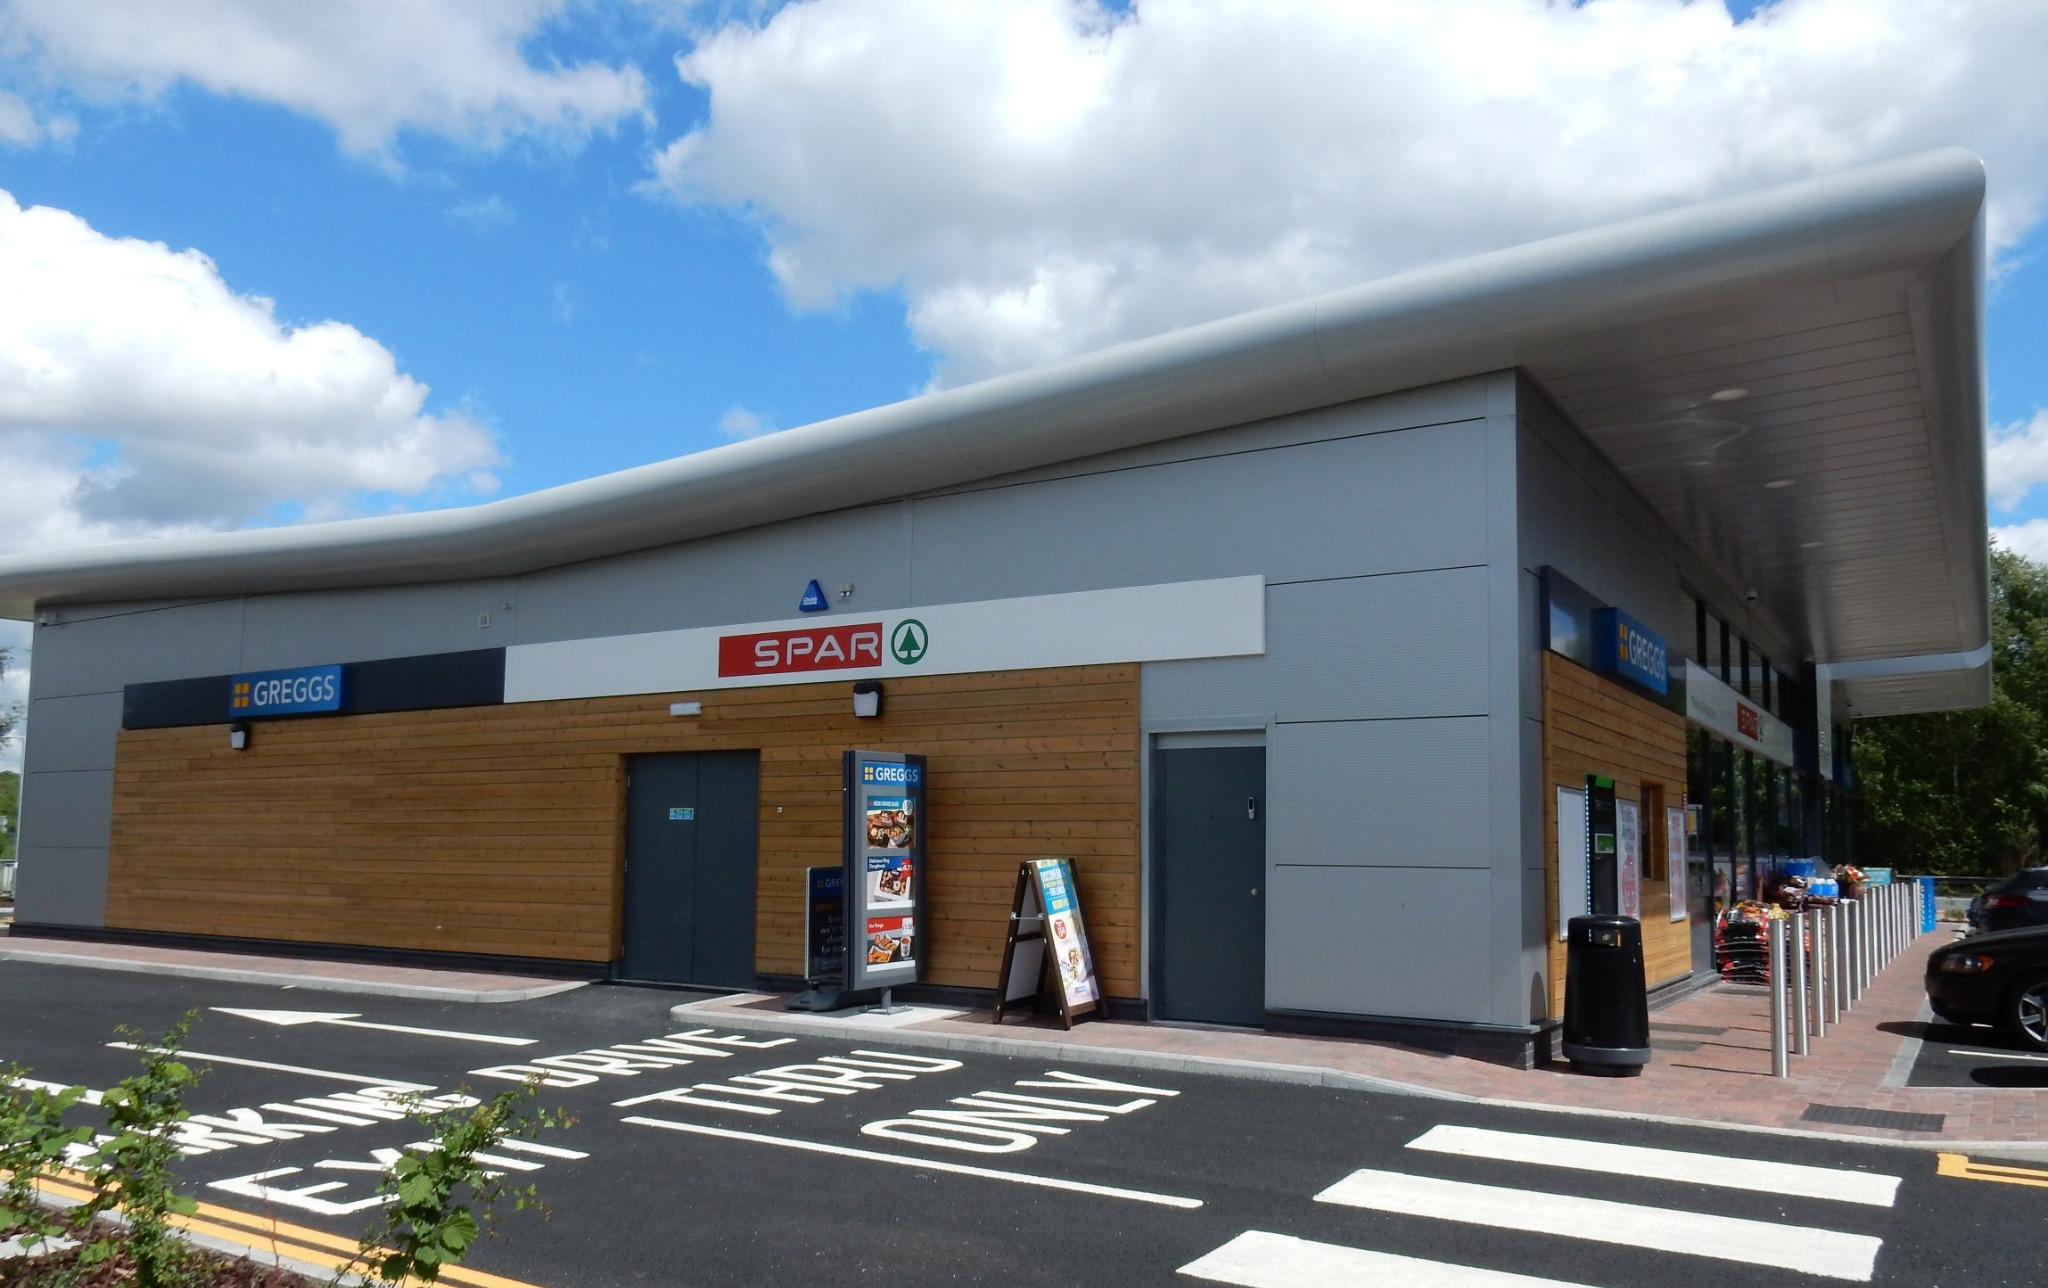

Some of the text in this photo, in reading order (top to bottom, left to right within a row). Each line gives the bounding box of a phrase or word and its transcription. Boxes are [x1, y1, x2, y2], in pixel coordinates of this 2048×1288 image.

[754, 631, 879, 668] SPAR
[1628, 629, 1665, 681] GREGGS
[254, 674, 335, 706] GREGGS
[875, 766, 919, 782] GREGGS
[825, 878, 843, 888] GRE
[467, 1028, 797, 1088] DRIVE
[611, 1049, 964, 1116] THRU
[860, 1070, 1181, 1154] ONLY
